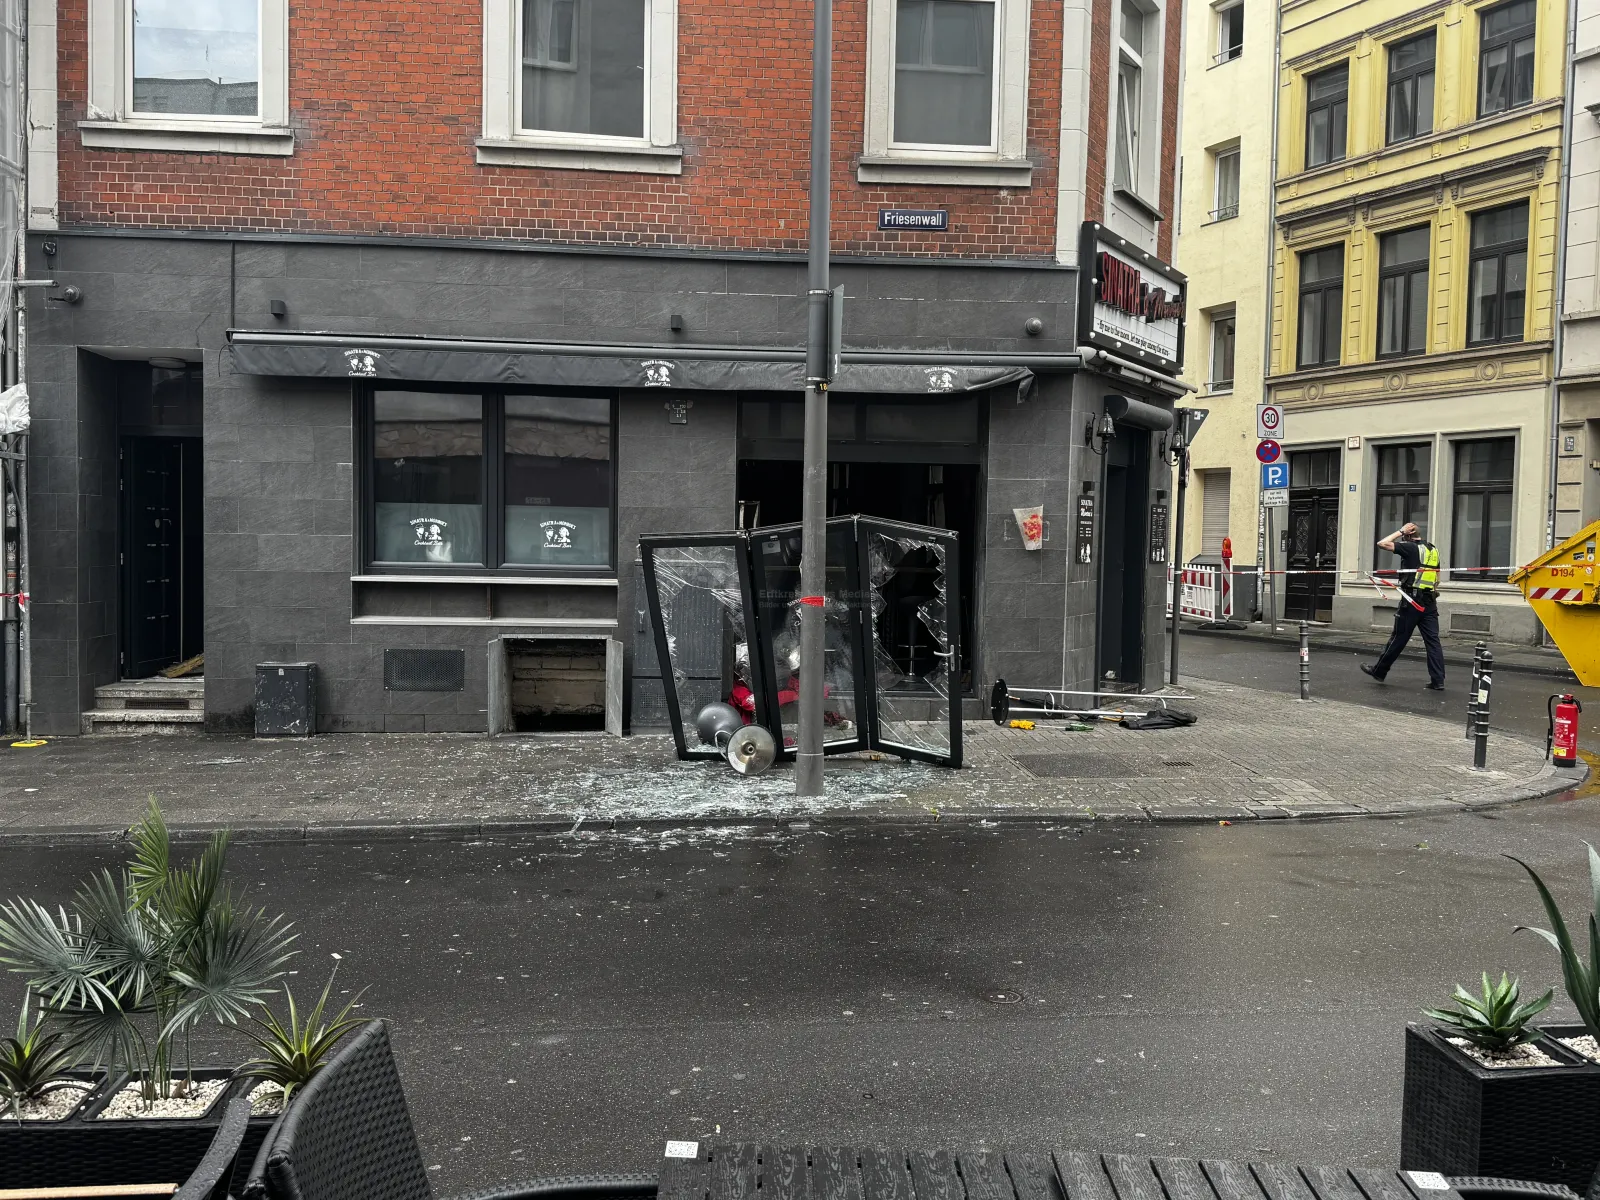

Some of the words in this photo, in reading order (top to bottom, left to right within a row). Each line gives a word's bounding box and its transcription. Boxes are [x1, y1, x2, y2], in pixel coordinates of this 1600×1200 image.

[884, 212, 942, 226] Friesenwall
[1099, 251, 1141, 316] SINATRA
[1265, 412, 1276, 424] 30
[1268, 467, 1282, 486] P
[1551, 567, 1575, 577] D194
